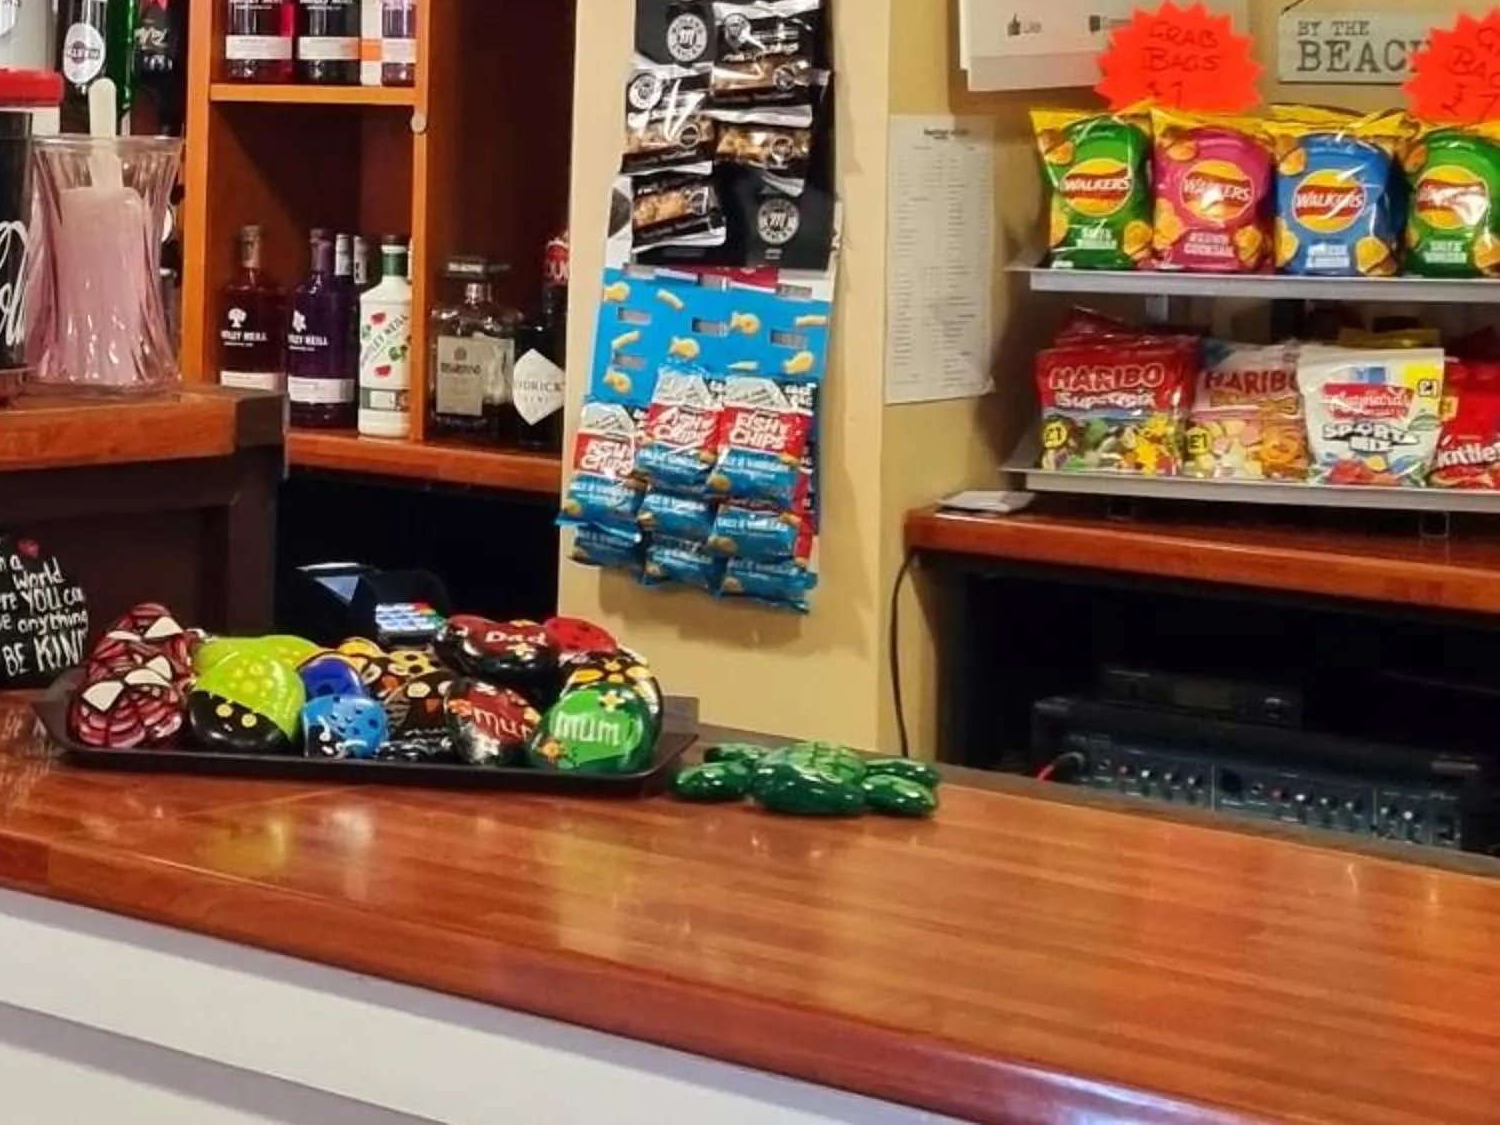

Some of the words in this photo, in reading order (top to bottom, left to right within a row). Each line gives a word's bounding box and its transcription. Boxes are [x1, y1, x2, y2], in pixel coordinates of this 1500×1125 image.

[1296, 20, 1322, 36] BY
[1331, 20, 1370, 36] THE
[1142, 47, 1222, 73] BAGS
[1061, 176, 1132, 192] WALKERS
[1049, 363, 1165, 392] HARIBO
[1189, 433, 1208, 450] £1
[20, 586, 62, 616] YOU
[62, 586, 86, 606] ca
[16, 609, 89, 636] anything
[484, 628, 549, 648] Dad
[1, 641, 30, 678] BE
